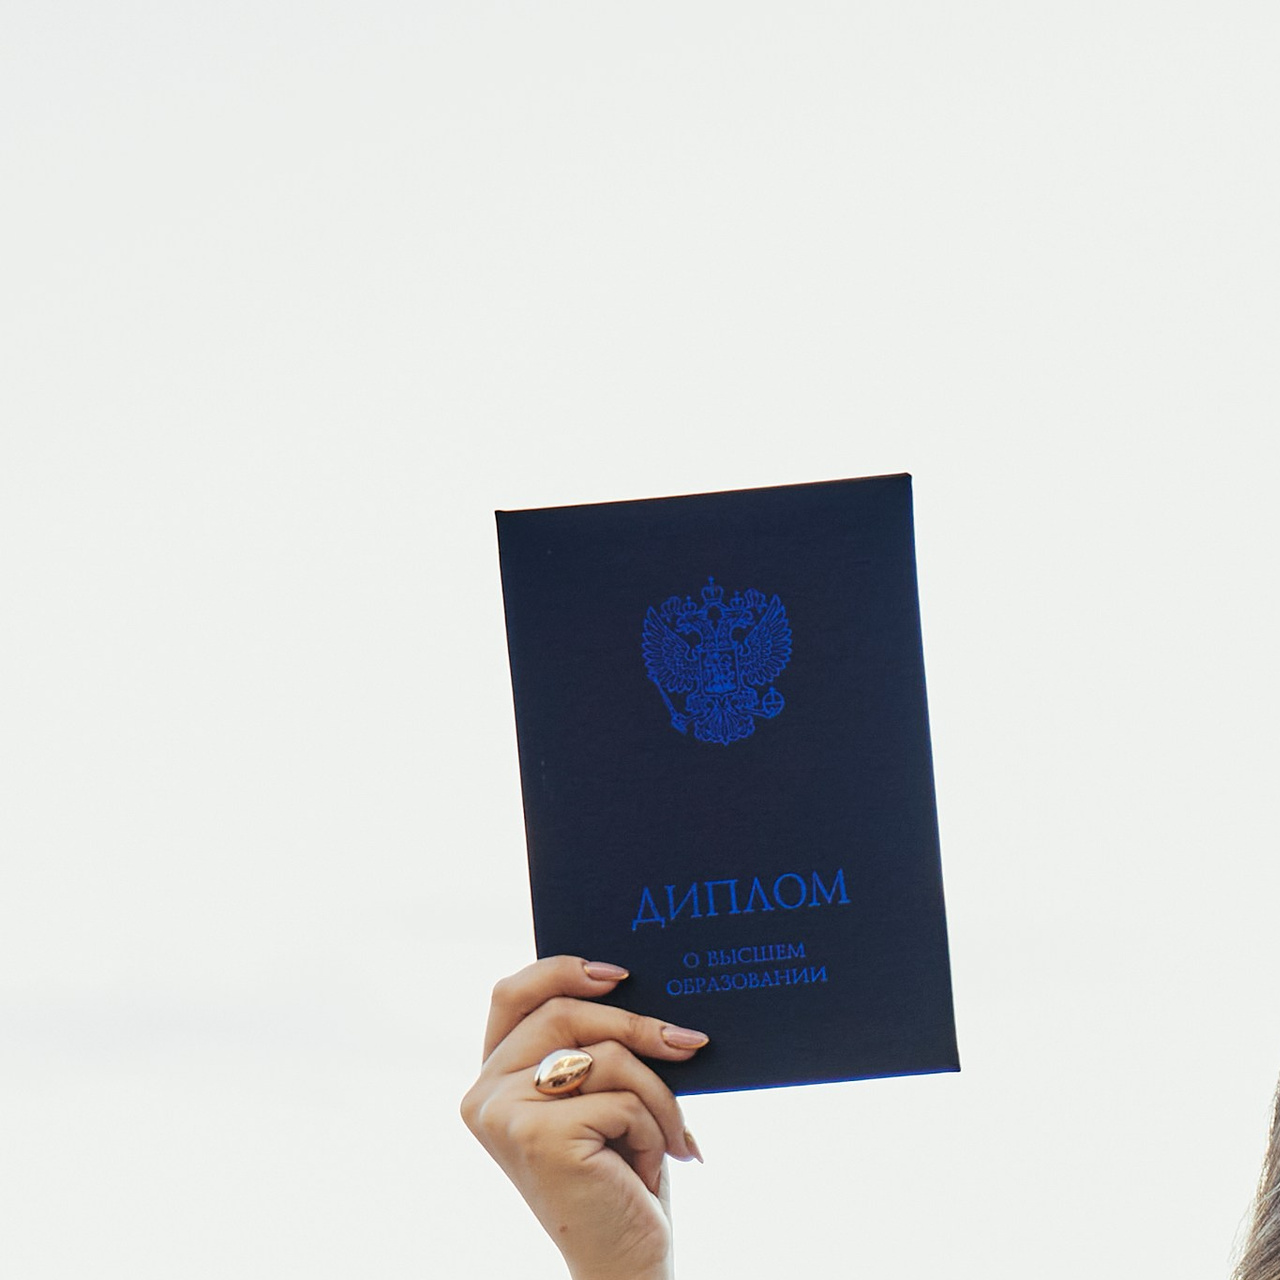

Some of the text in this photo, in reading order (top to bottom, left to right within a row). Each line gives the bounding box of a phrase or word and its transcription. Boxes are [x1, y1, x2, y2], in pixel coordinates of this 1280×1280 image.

[631, 868, 852, 931] ДИПЛОМ
[682, 942, 806, 969] О ВЫСШЕМ
[665, 965, 828, 996] ОБРАЗОВАНИИ
